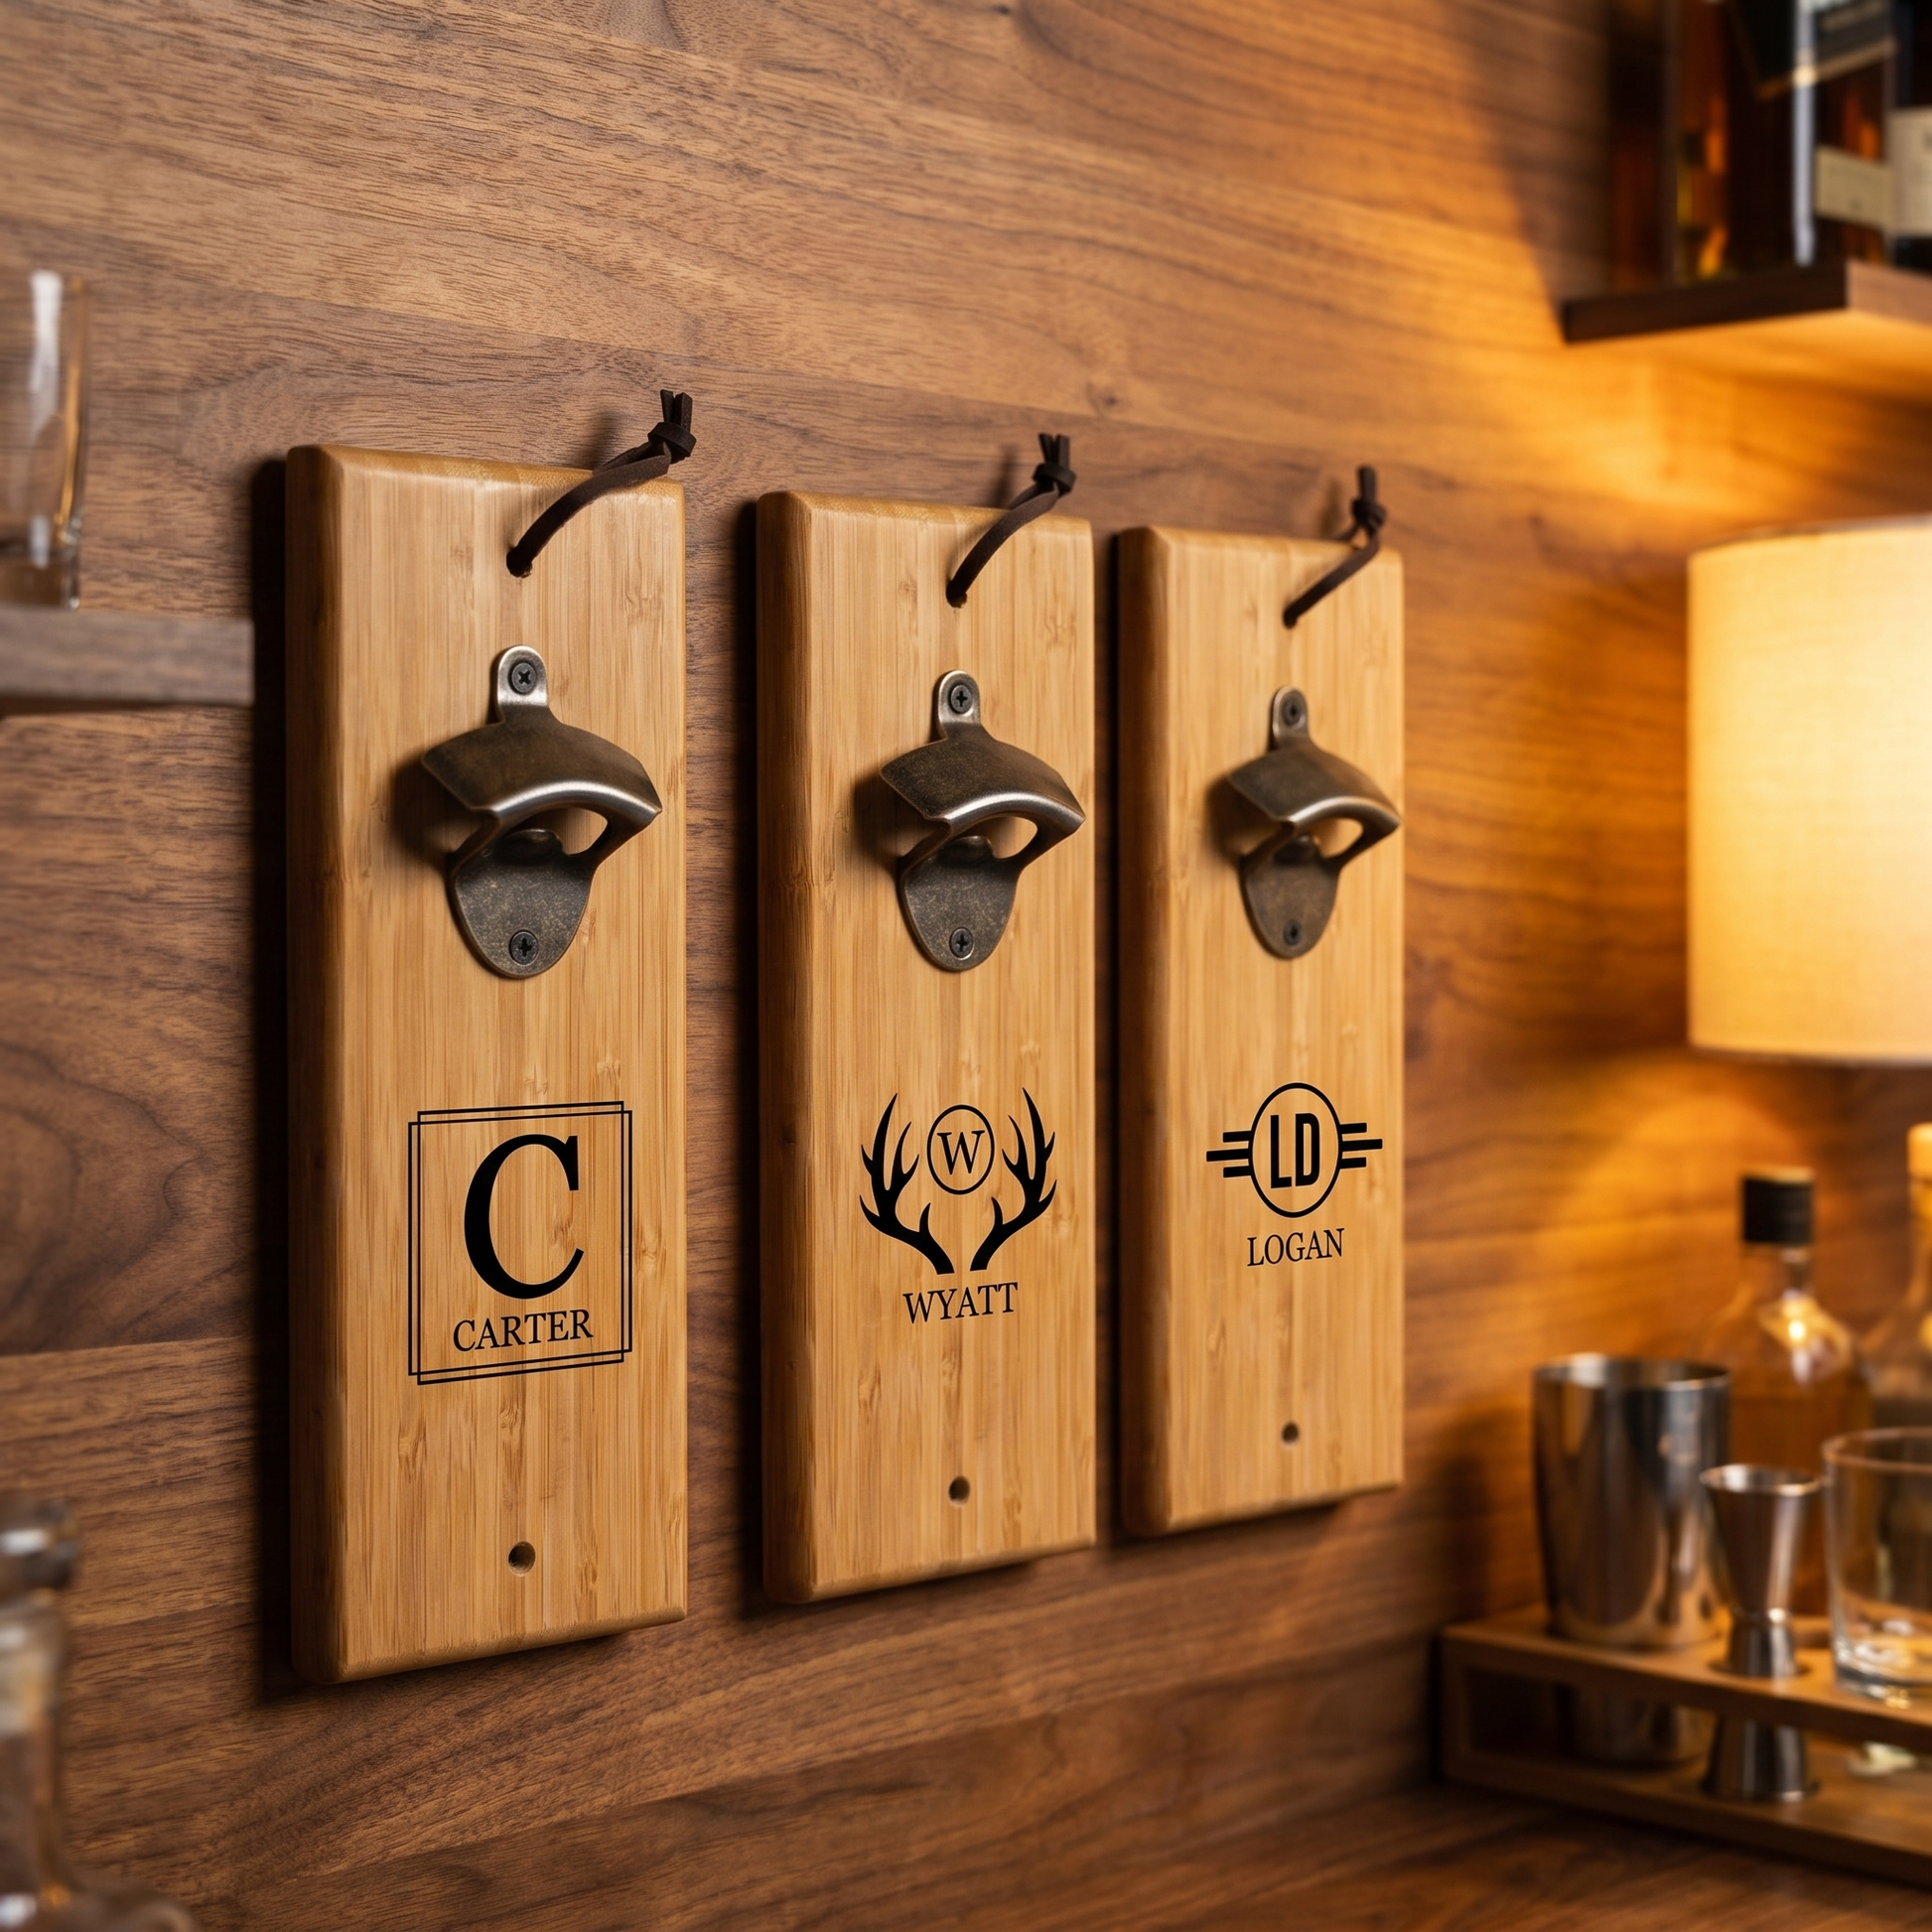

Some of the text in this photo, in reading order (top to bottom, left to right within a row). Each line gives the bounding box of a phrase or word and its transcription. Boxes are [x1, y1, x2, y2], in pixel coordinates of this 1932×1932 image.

[936, 1130, 986, 1175] W
[1270, 1113, 1320, 1188] LD
[464, 1134, 585, 1300] C
[1247, 1228, 1345, 1267] LOGAN
[901, 1282, 1019, 1324] WYATT
[453, 1309, 594, 1352] CARTER
